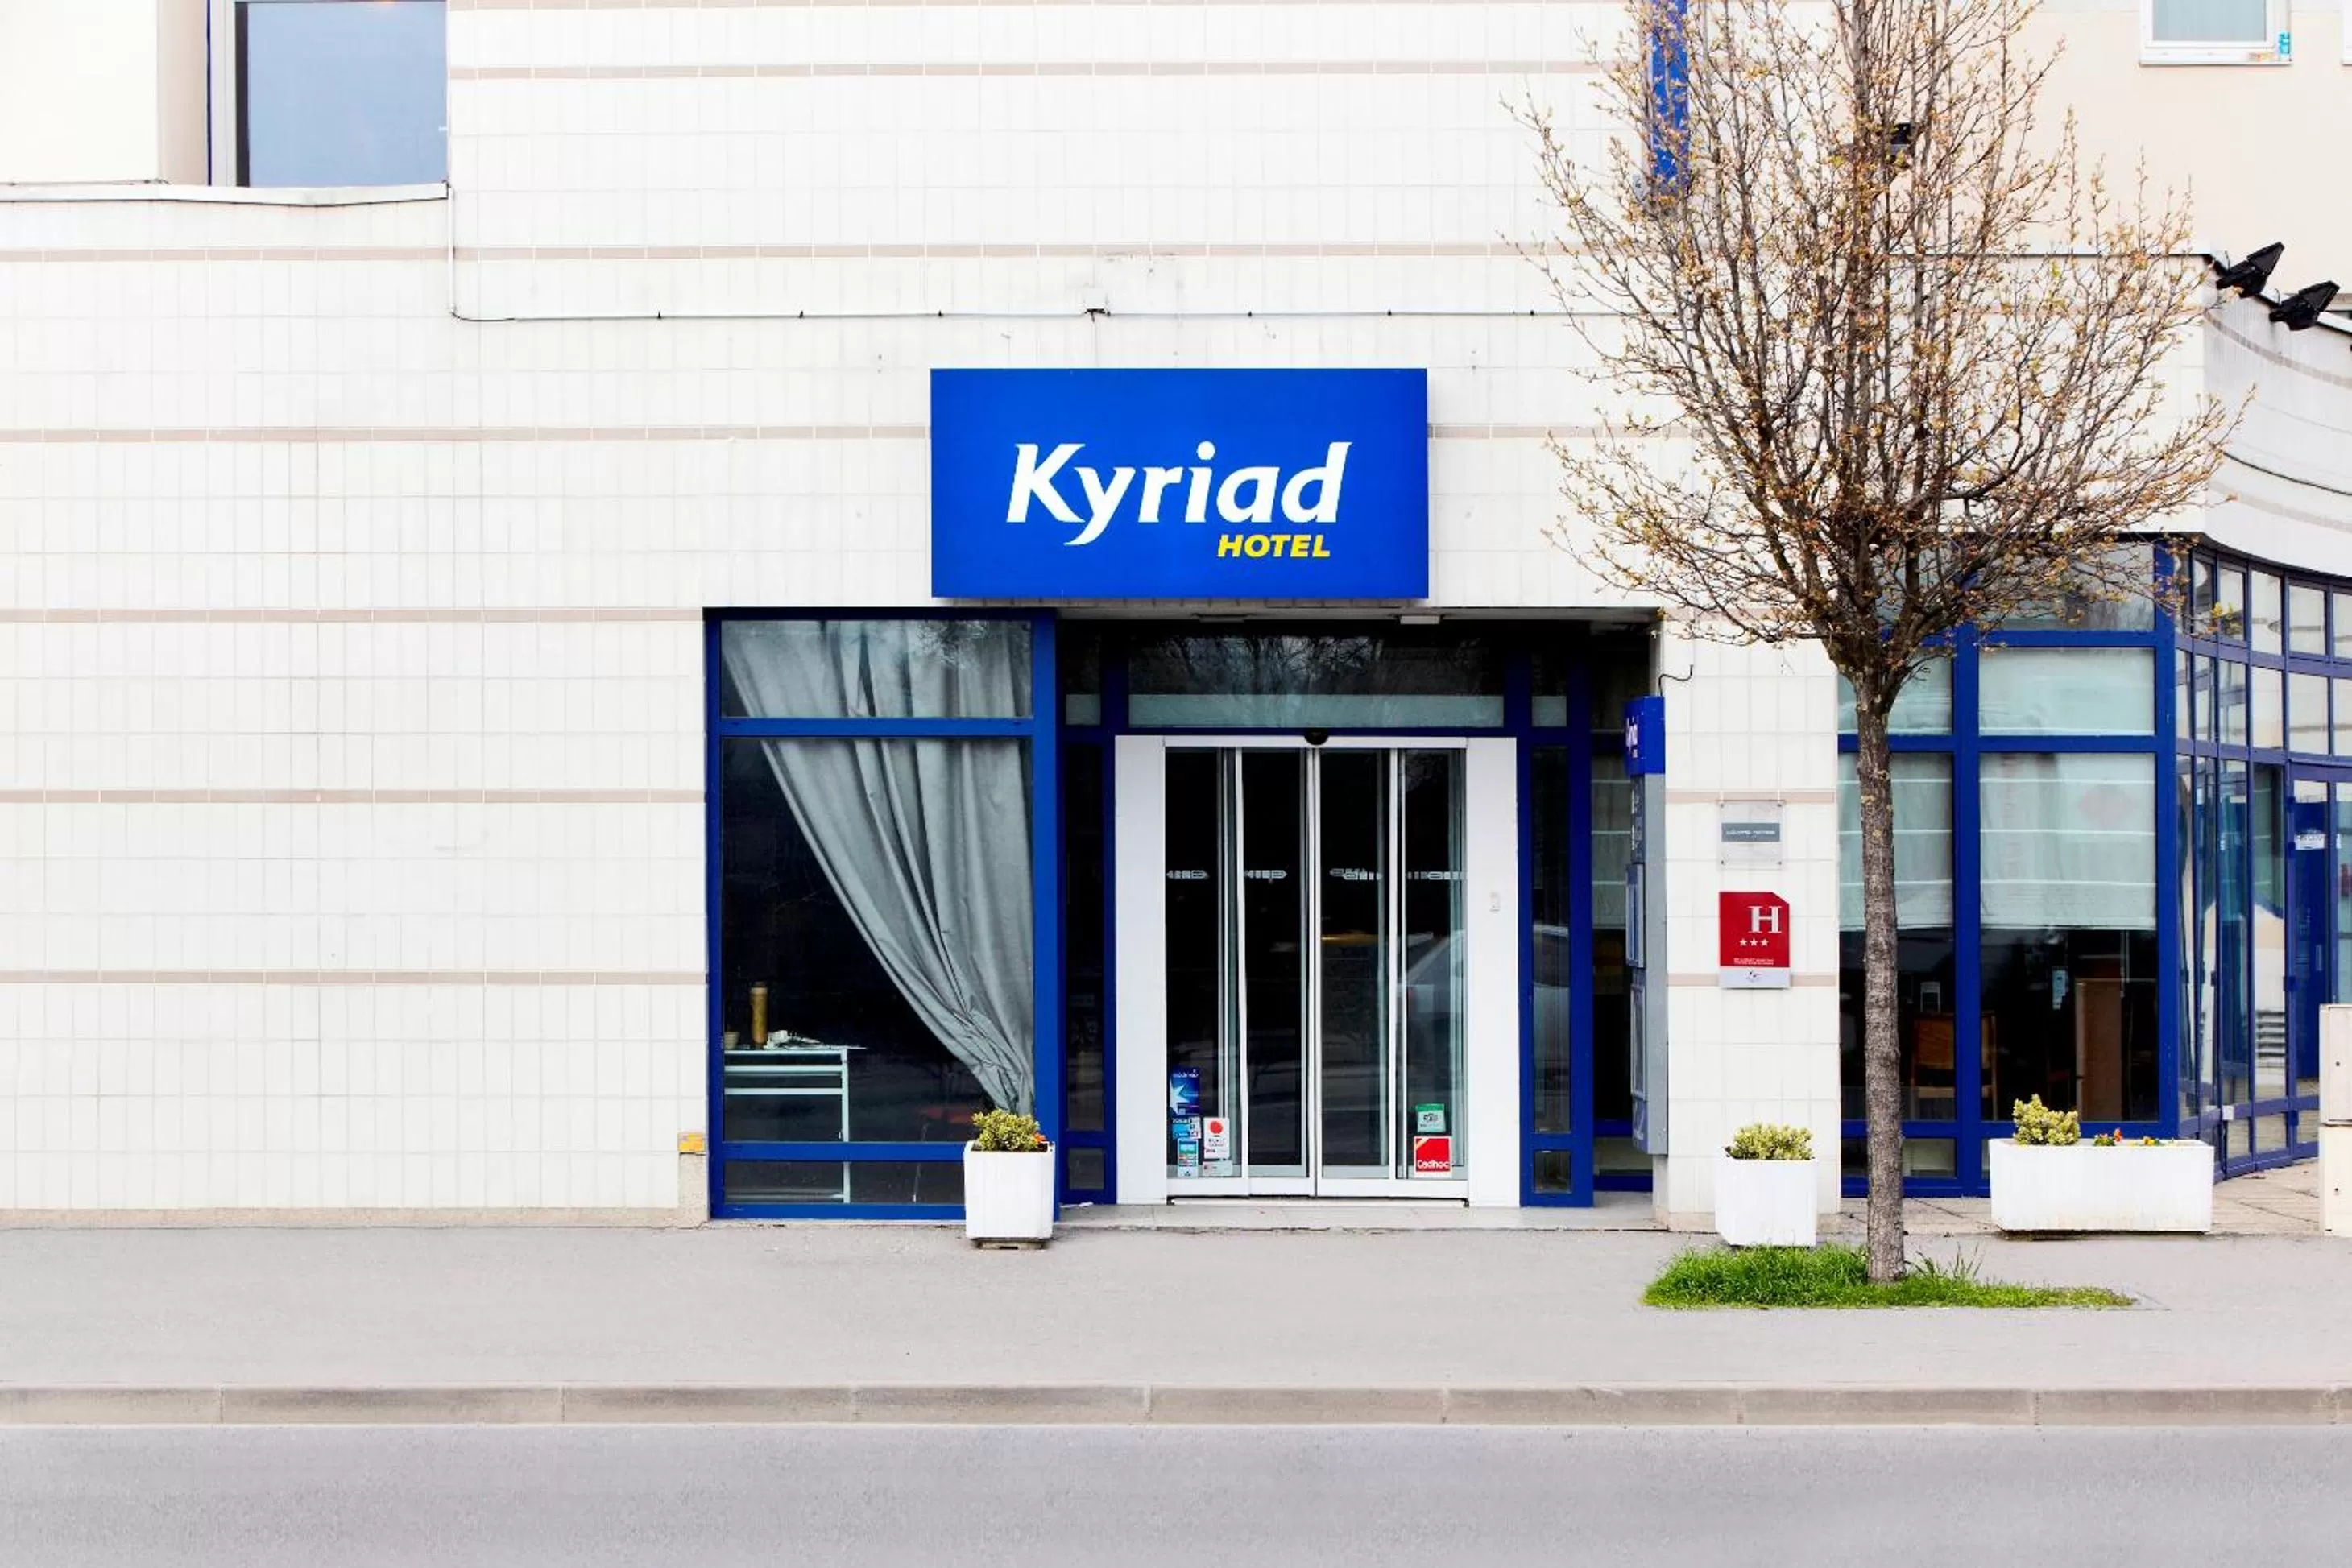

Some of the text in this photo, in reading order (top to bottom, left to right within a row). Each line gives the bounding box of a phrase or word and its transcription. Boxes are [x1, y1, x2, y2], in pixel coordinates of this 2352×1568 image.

[1007, 441, 1352, 546] Kyriad
[1217, 535, 1330, 557] HOTEL
[1747, 905, 1782, 933] H
